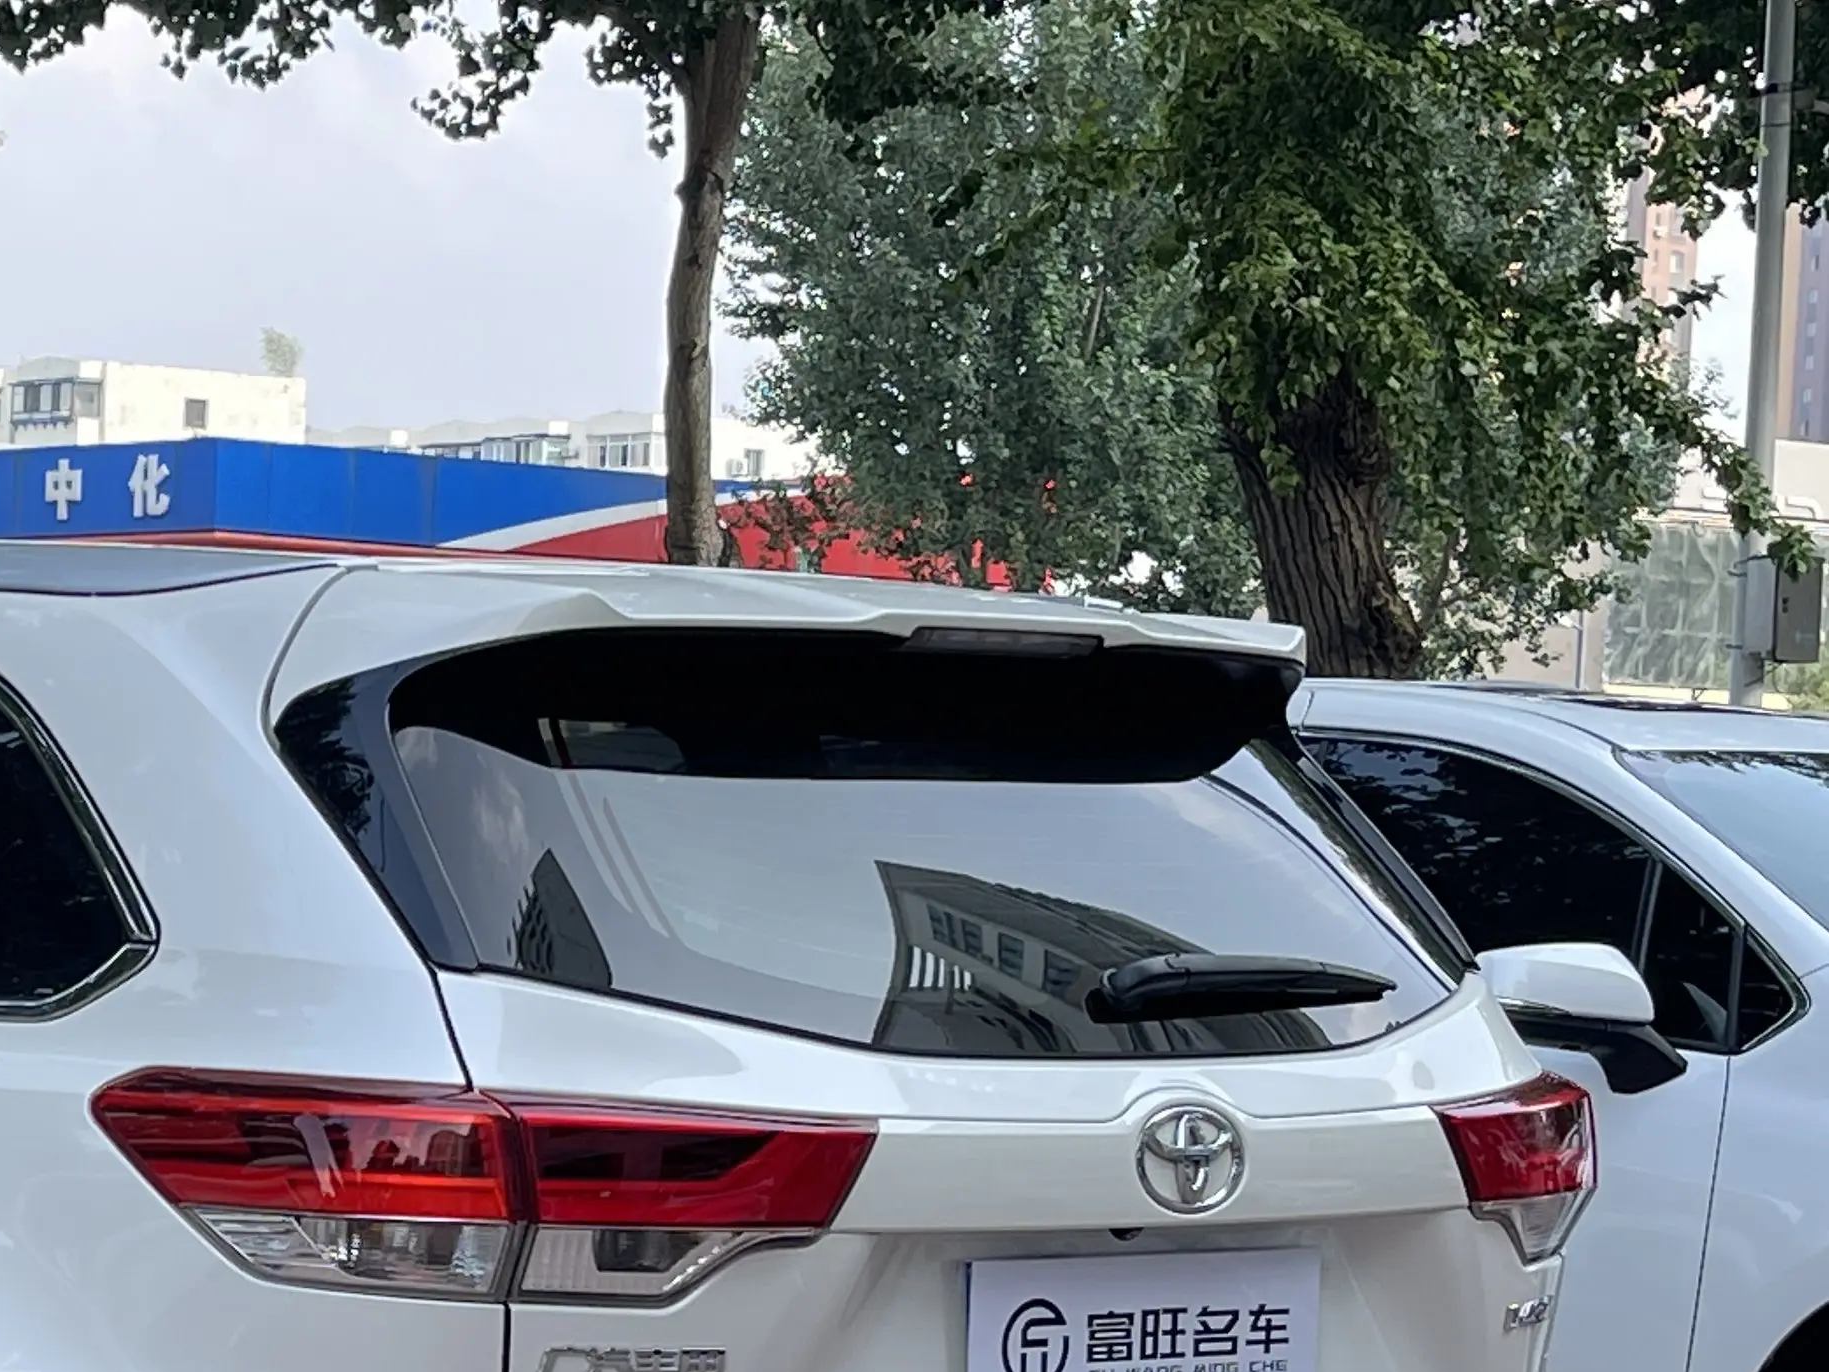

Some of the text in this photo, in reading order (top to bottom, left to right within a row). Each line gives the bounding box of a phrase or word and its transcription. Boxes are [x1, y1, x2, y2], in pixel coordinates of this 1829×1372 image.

[45, 453, 171, 521] 中化
[1086, 1303, 1291, 1363] 富旺名车
